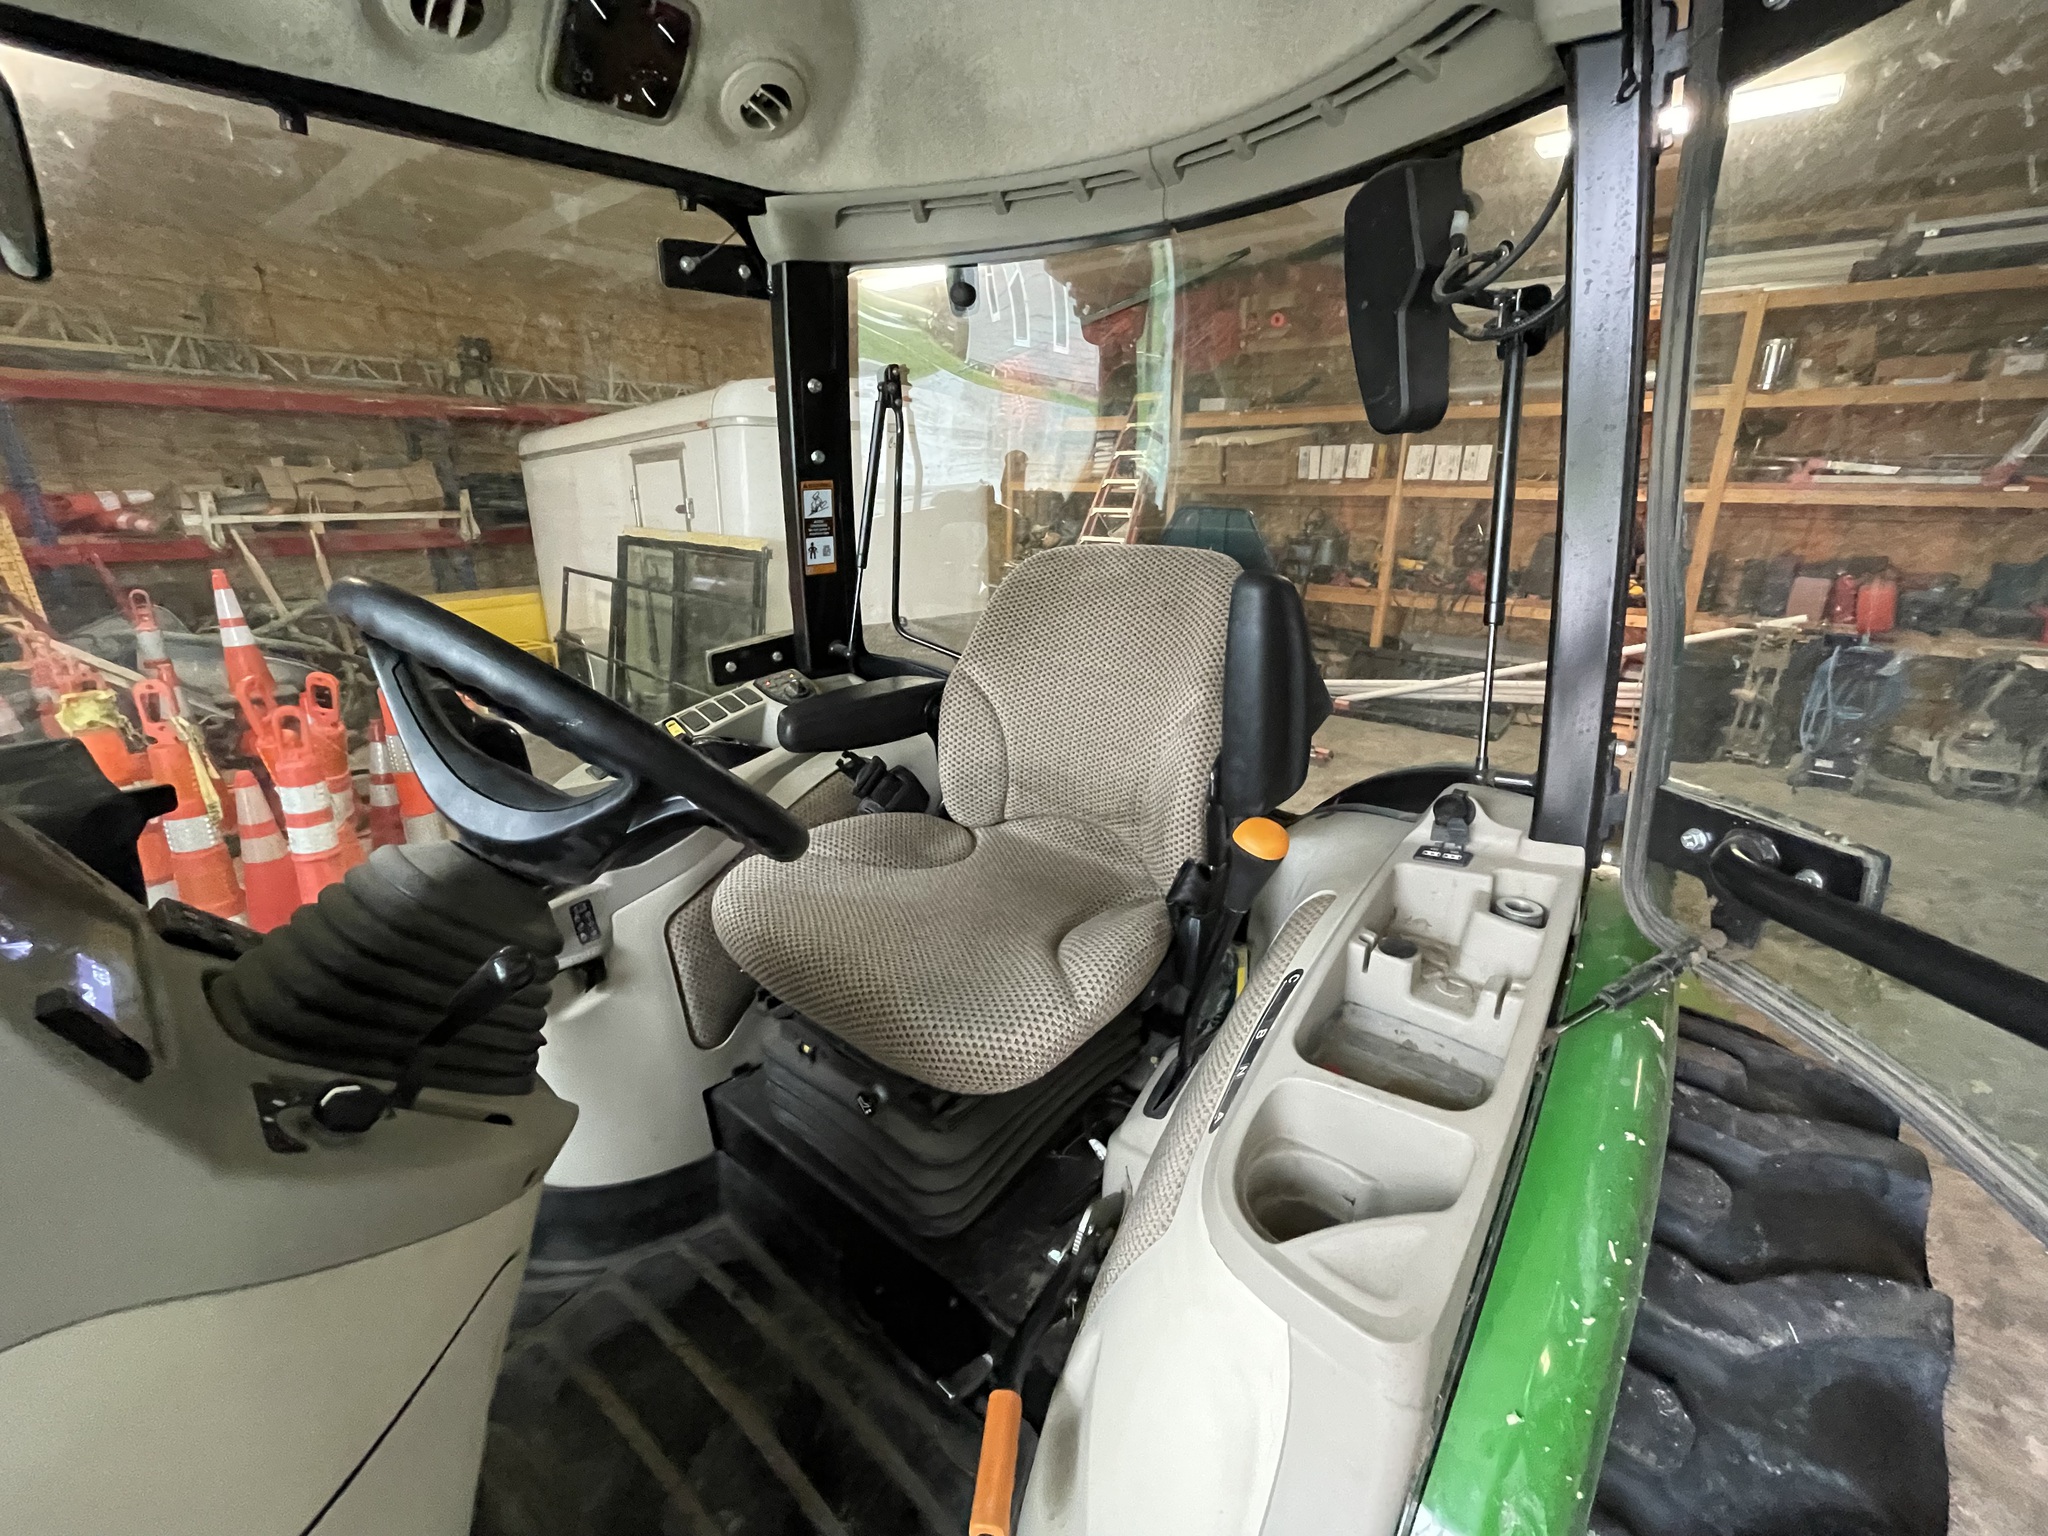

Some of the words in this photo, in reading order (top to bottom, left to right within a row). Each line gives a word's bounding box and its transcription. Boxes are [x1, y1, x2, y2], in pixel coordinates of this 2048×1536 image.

[1288, 973, 1300, 984] C
[1256, 1028, 1268, 1039] B
[1236, 1065, 1249, 1077] N
